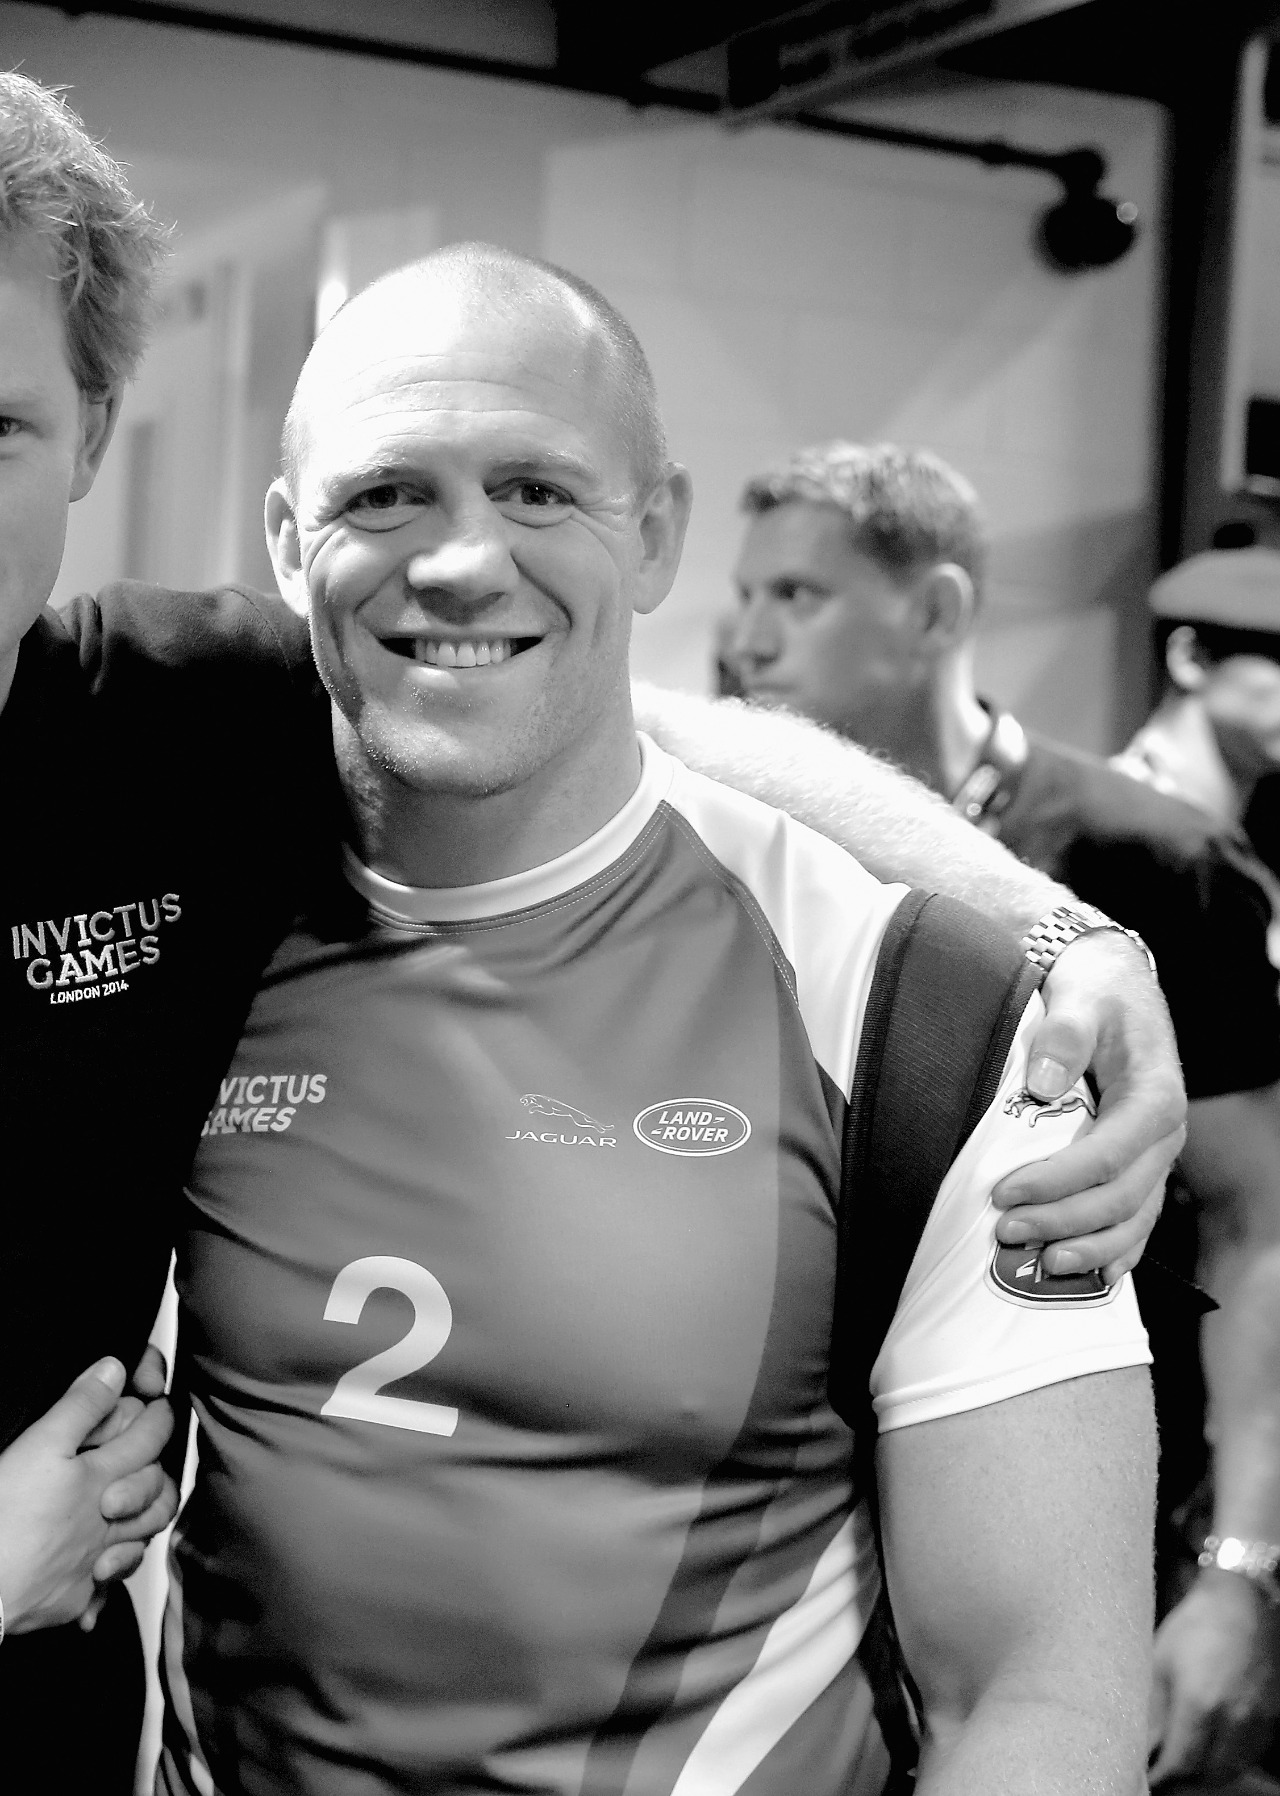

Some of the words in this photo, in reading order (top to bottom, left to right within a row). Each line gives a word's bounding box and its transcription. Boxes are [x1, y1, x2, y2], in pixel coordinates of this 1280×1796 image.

[11, 893, 182, 959] INVICTUS
[26, 935, 161, 989] GAMES
[50, 985, 101, 1005] LONDON
[103, 979, 130, 997] 2014
[219, 1073, 328, 1105] VICTUS
[658, 1110, 713, 1126] LAND
[504, 1130, 617, 1148] JAGUAR
[661, 1126, 730, 1143] ROVER
[320, 1255, 459, 1438] 2
